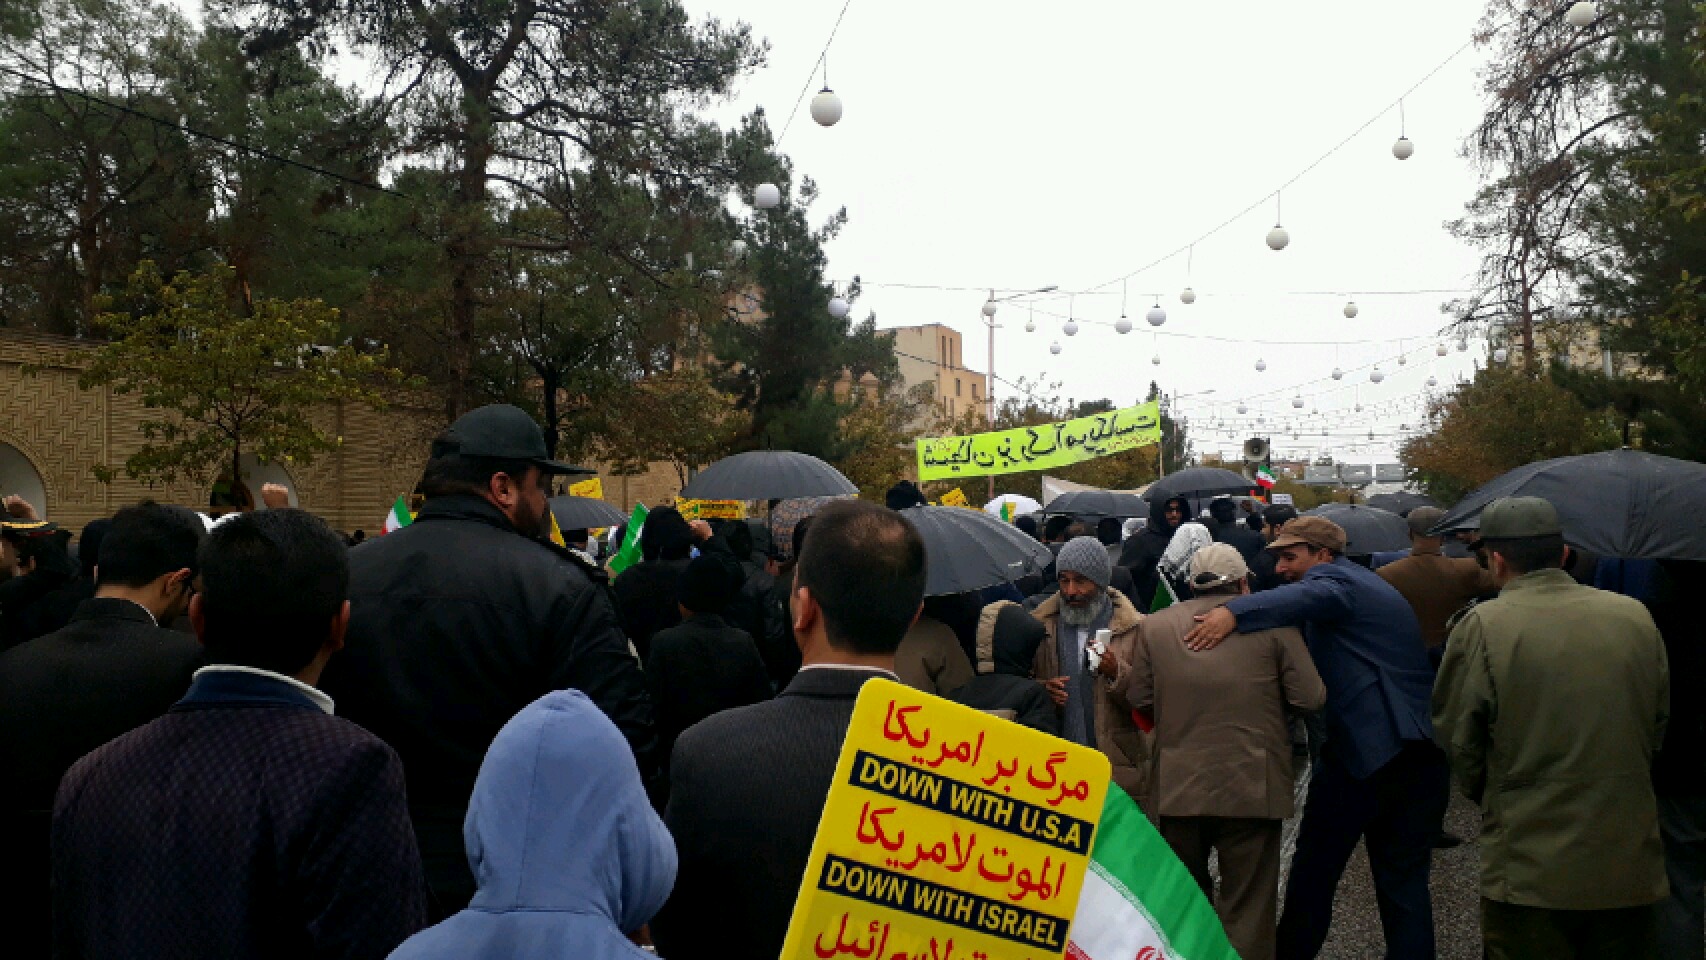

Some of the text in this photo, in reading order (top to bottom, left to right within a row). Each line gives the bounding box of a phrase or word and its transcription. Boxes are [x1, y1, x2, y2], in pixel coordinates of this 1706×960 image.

[980, 754, 1019, 793] بر
[1026, 752, 1090, 806] مرگ
[860, 758, 1083, 850] DOWN WITH U.S.A
[977, 848, 1066, 901] الموت
[826, 858, 1060, 949] DOWN WITH ISRAEL
